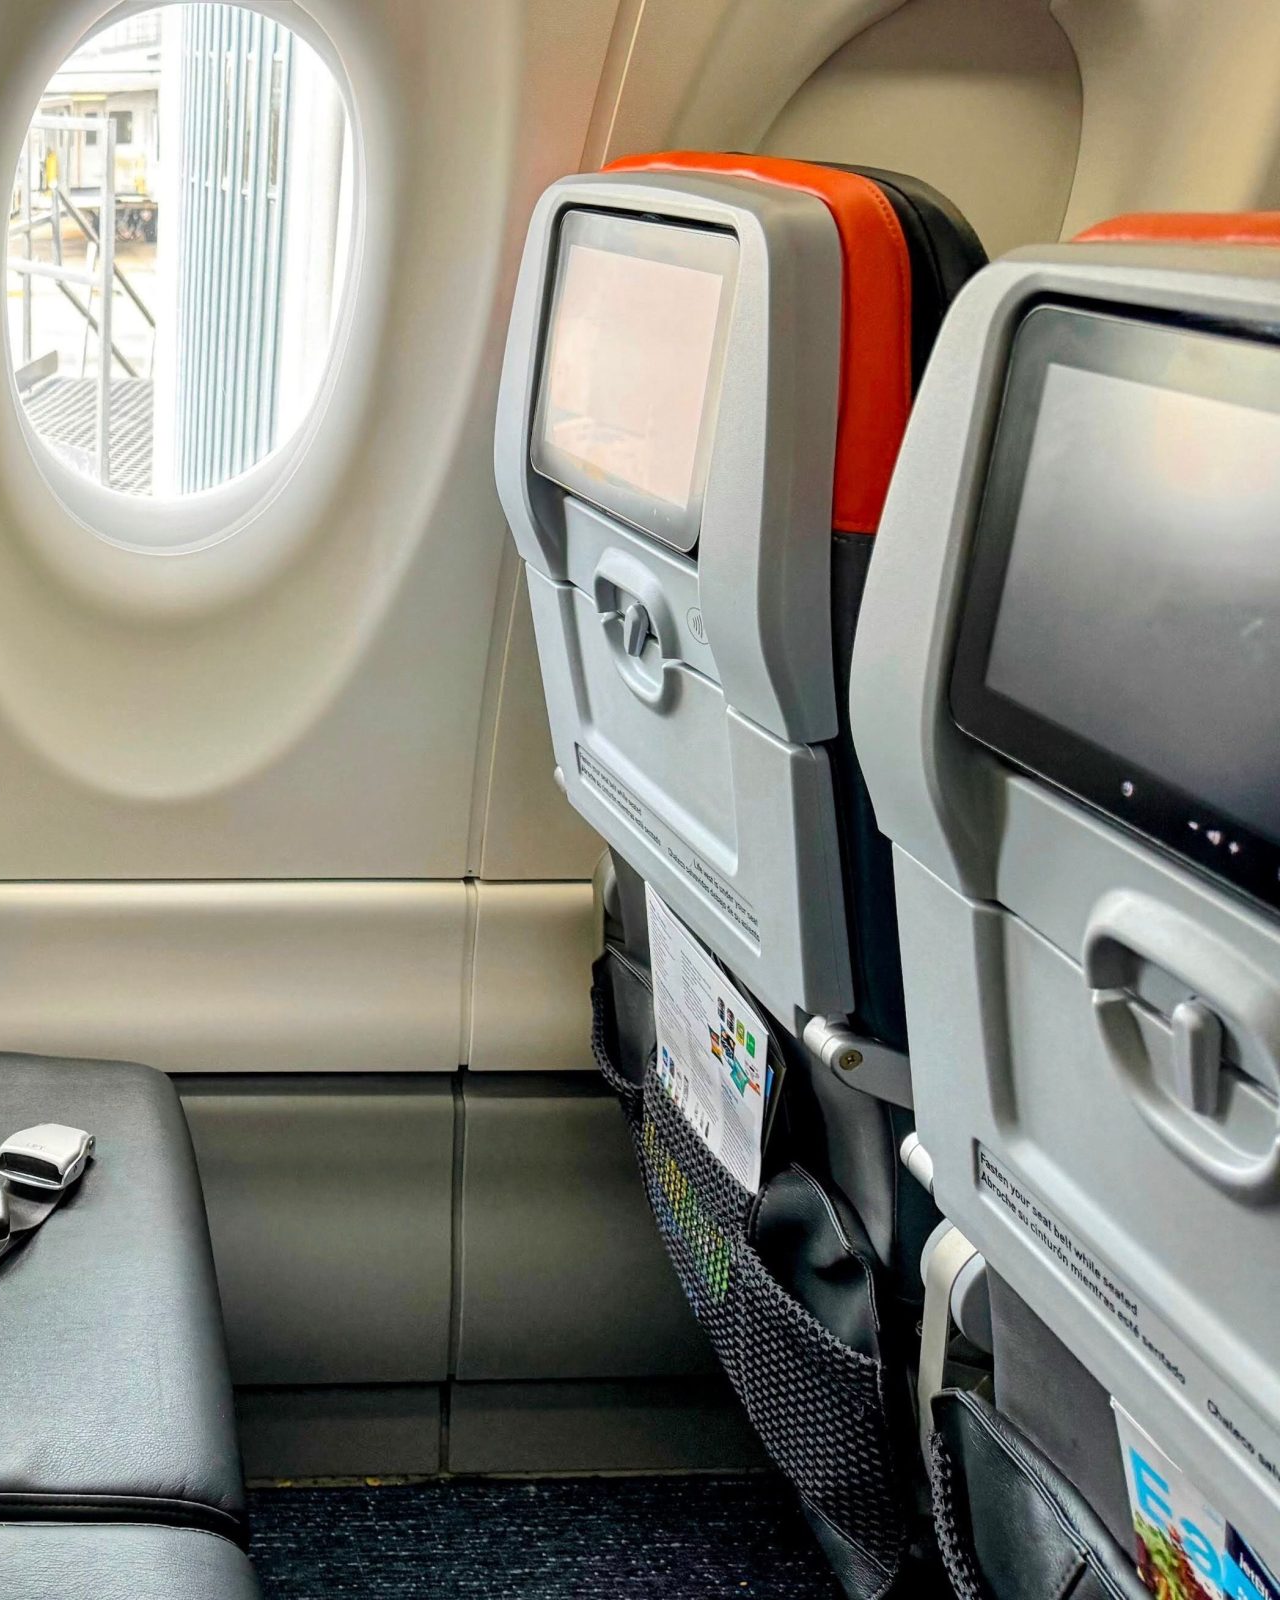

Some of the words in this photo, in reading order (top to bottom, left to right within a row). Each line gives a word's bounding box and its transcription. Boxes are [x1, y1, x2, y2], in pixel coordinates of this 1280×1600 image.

[980, 1152, 1009, 1189] Fasten
[1010, 1183, 1031, 1208] your
[1032, 1205, 1052, 1231] seat
[1054, 1225, 1072, 1252] belt
[1074, 1247, 1102, 1280] while
[1103, 1277, 1138, 1316] seated
[980, 1171, 1017, 1213] Abroche
[1018, 1209, 1029, 1226] su
[1030, 1222, 1069, 1266] cinturón
[1070, 1263, 1116, 1314] mientras
[1117, 1311, 1140, 1338] esté
[1141, 1335, 1186, 1385] sentado
